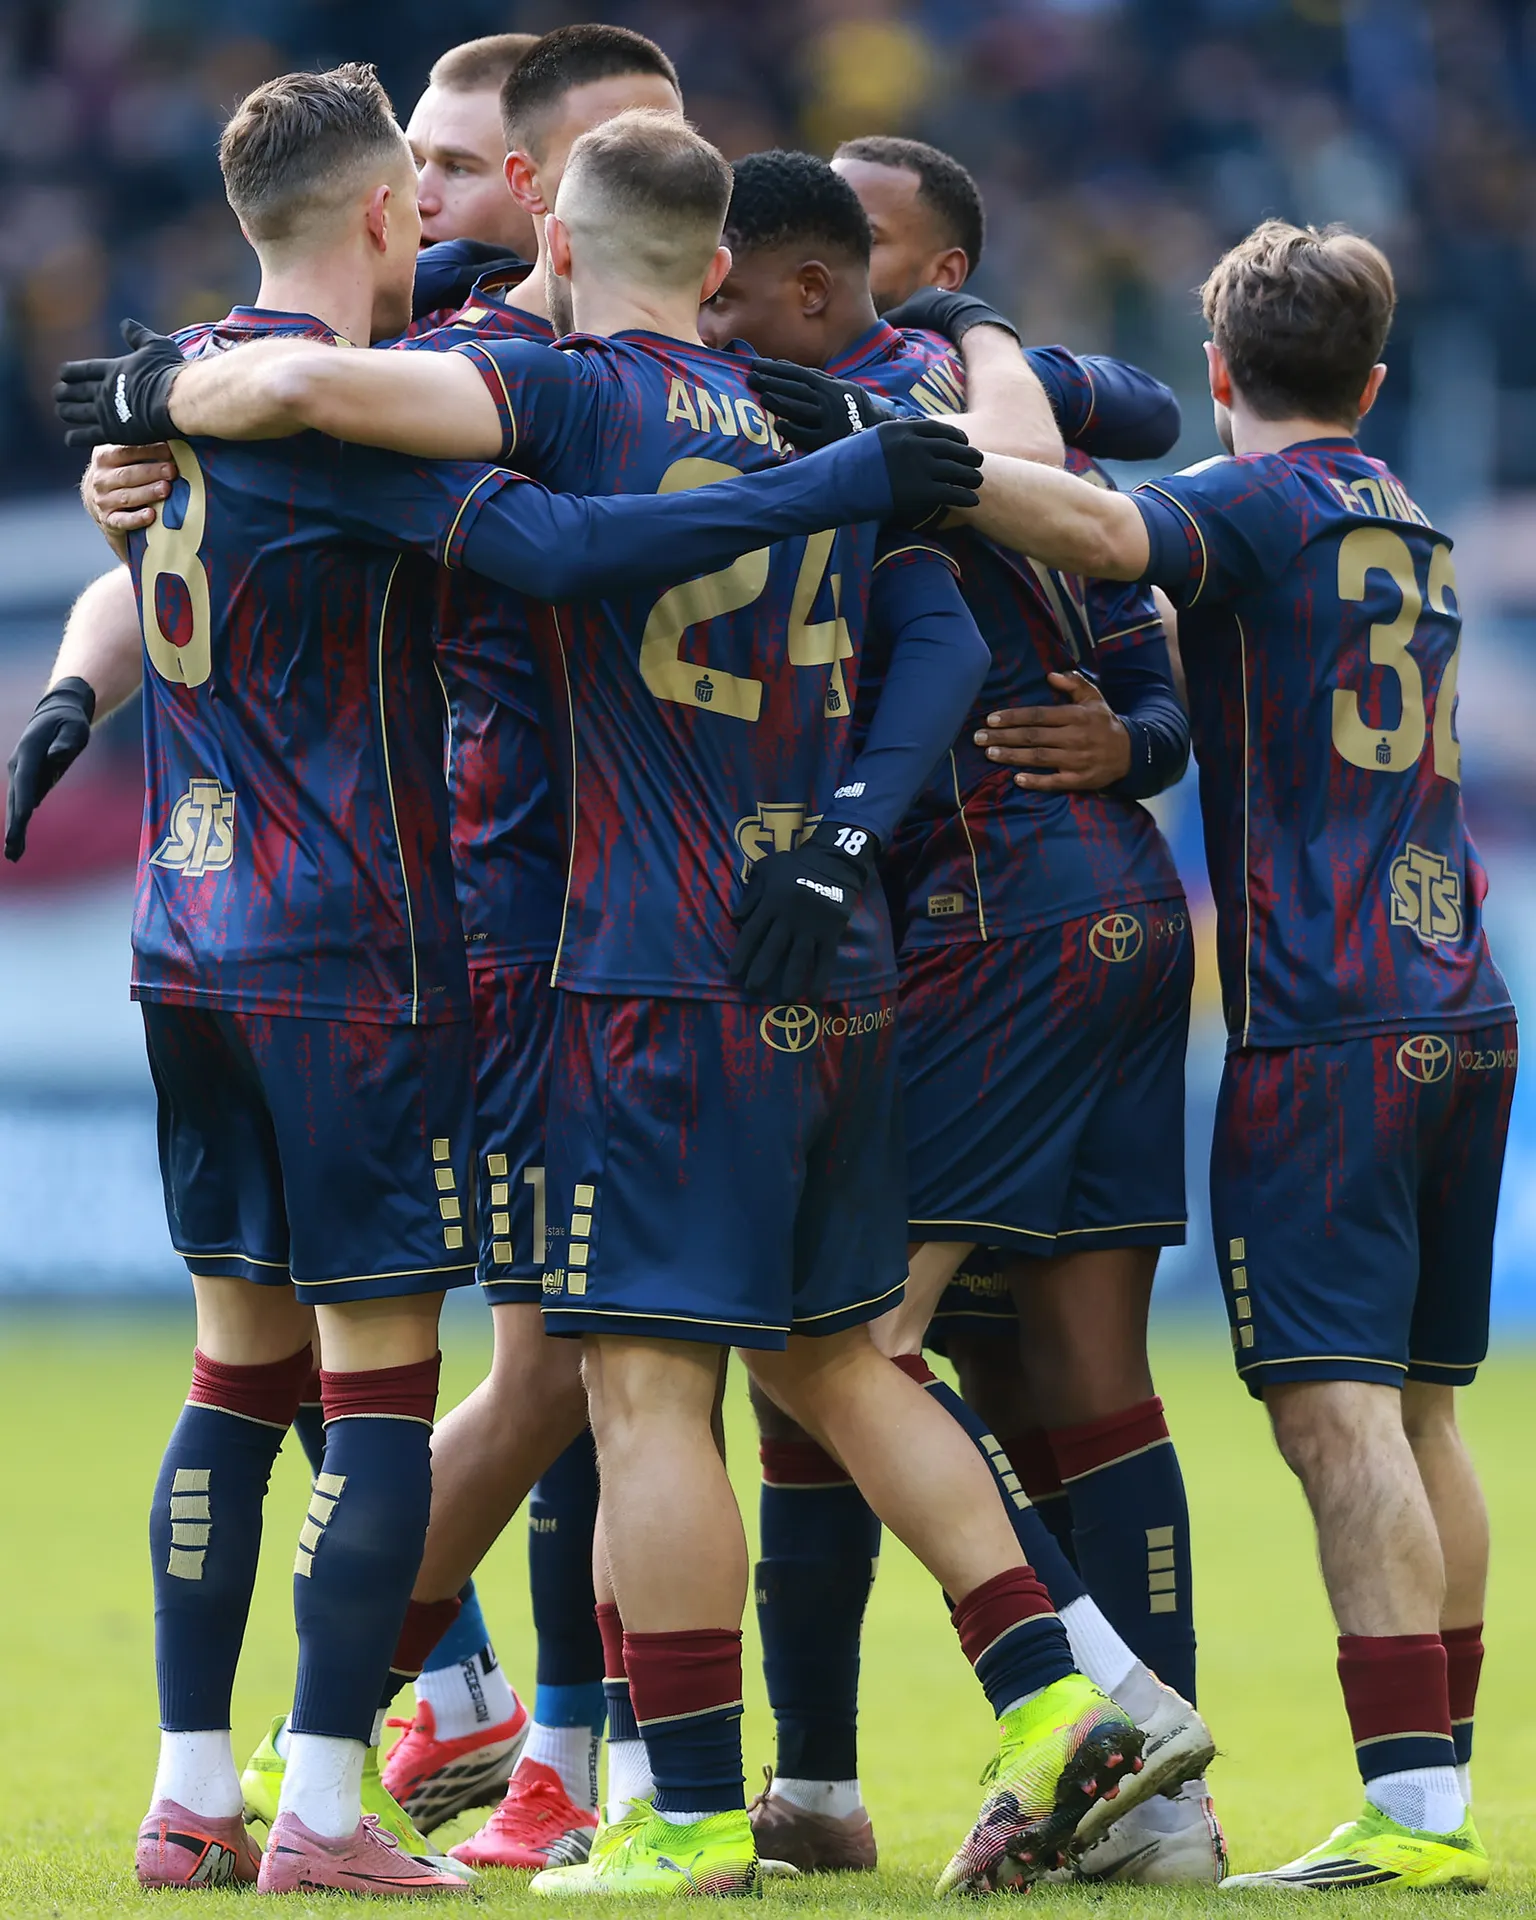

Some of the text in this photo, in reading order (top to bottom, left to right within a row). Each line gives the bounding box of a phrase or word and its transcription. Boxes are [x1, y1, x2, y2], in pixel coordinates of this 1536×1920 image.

[141, 438, 211, 689] 8
[639, 447, 853, 722] 24
[1332, 526, 1462, 785] 32
[149, 778, 236, 877] STS
[834, 827, 867, 856] 18
[1390, 842, 1463, 944] STS
